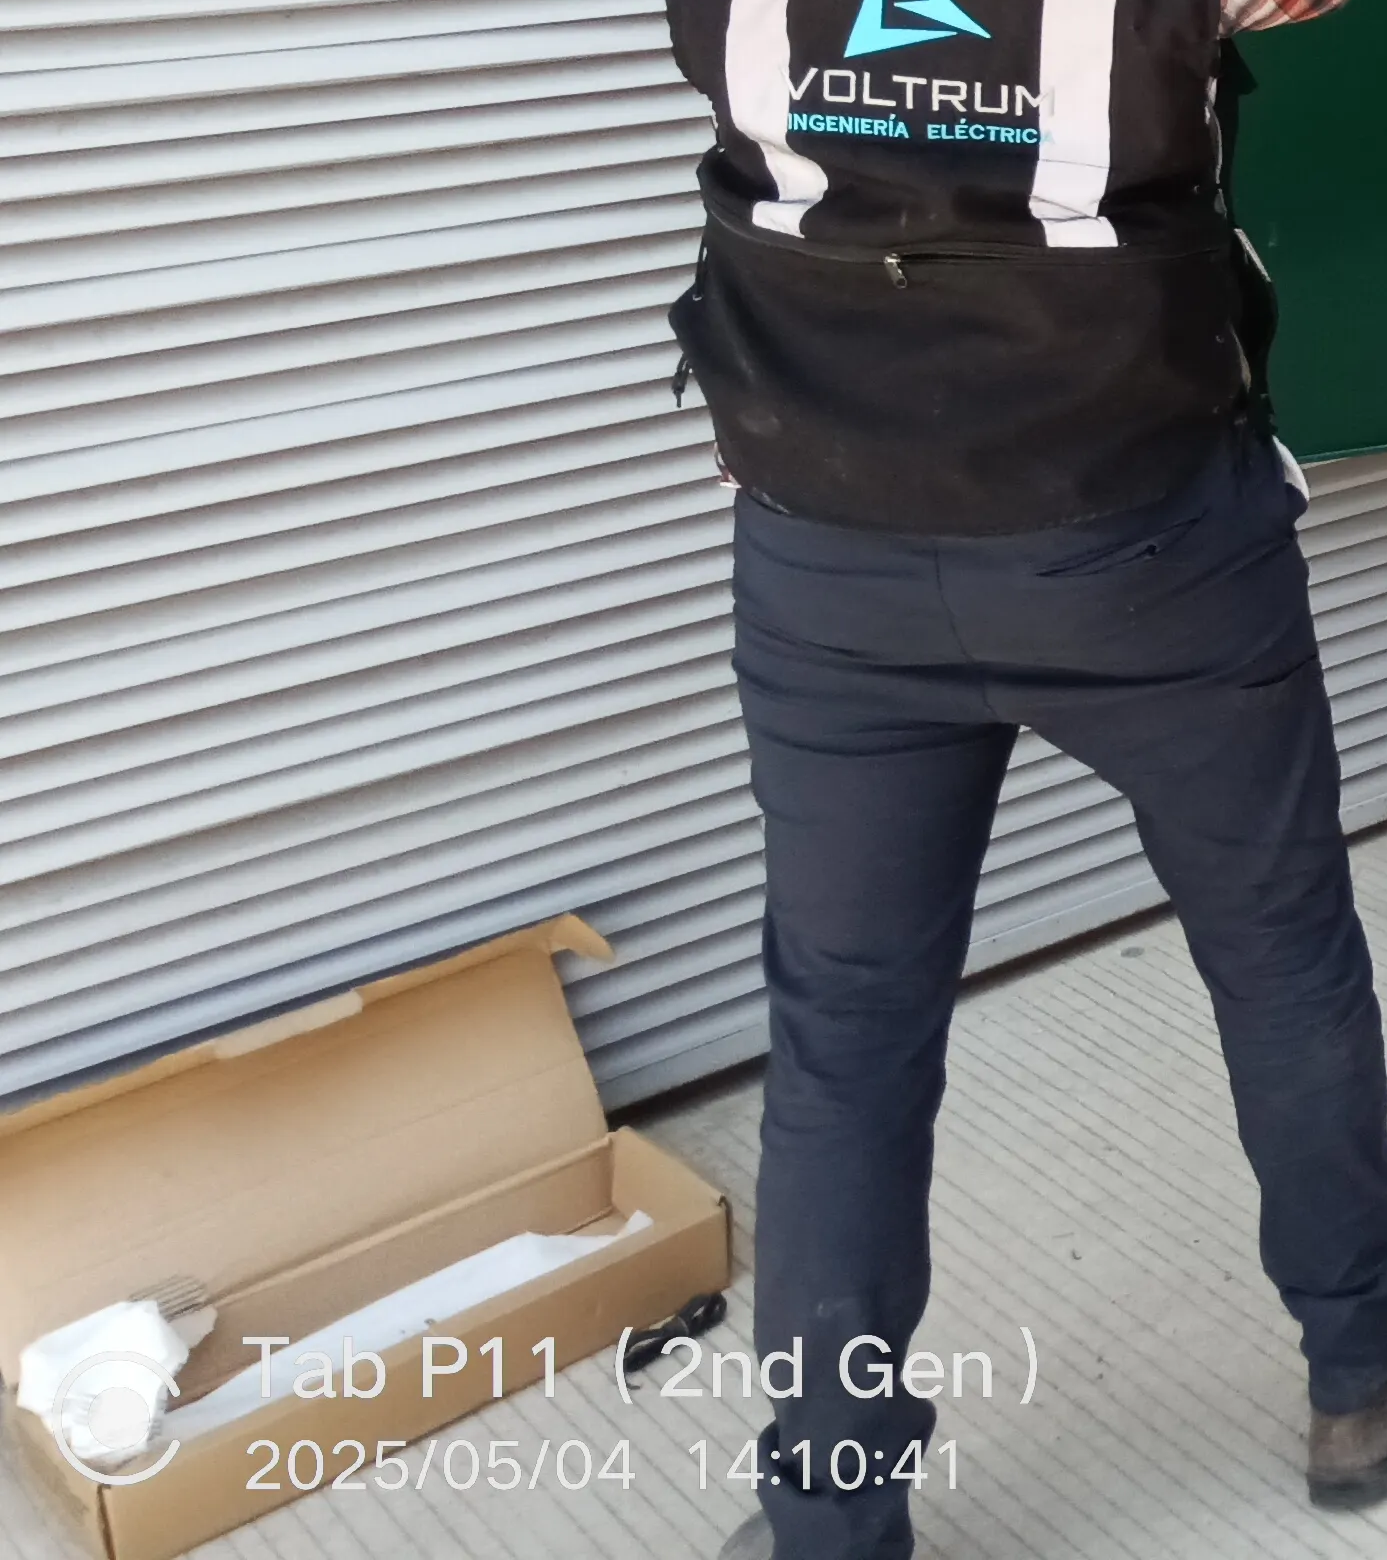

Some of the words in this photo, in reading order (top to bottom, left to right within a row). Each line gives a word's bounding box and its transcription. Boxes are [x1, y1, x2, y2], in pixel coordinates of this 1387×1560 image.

[779, 67, 1055, 117] VOLTRUM
[788, 112, 910, 139] INGENIERÍA
[926, 118, 1055, 145] ELÉCTRICA
